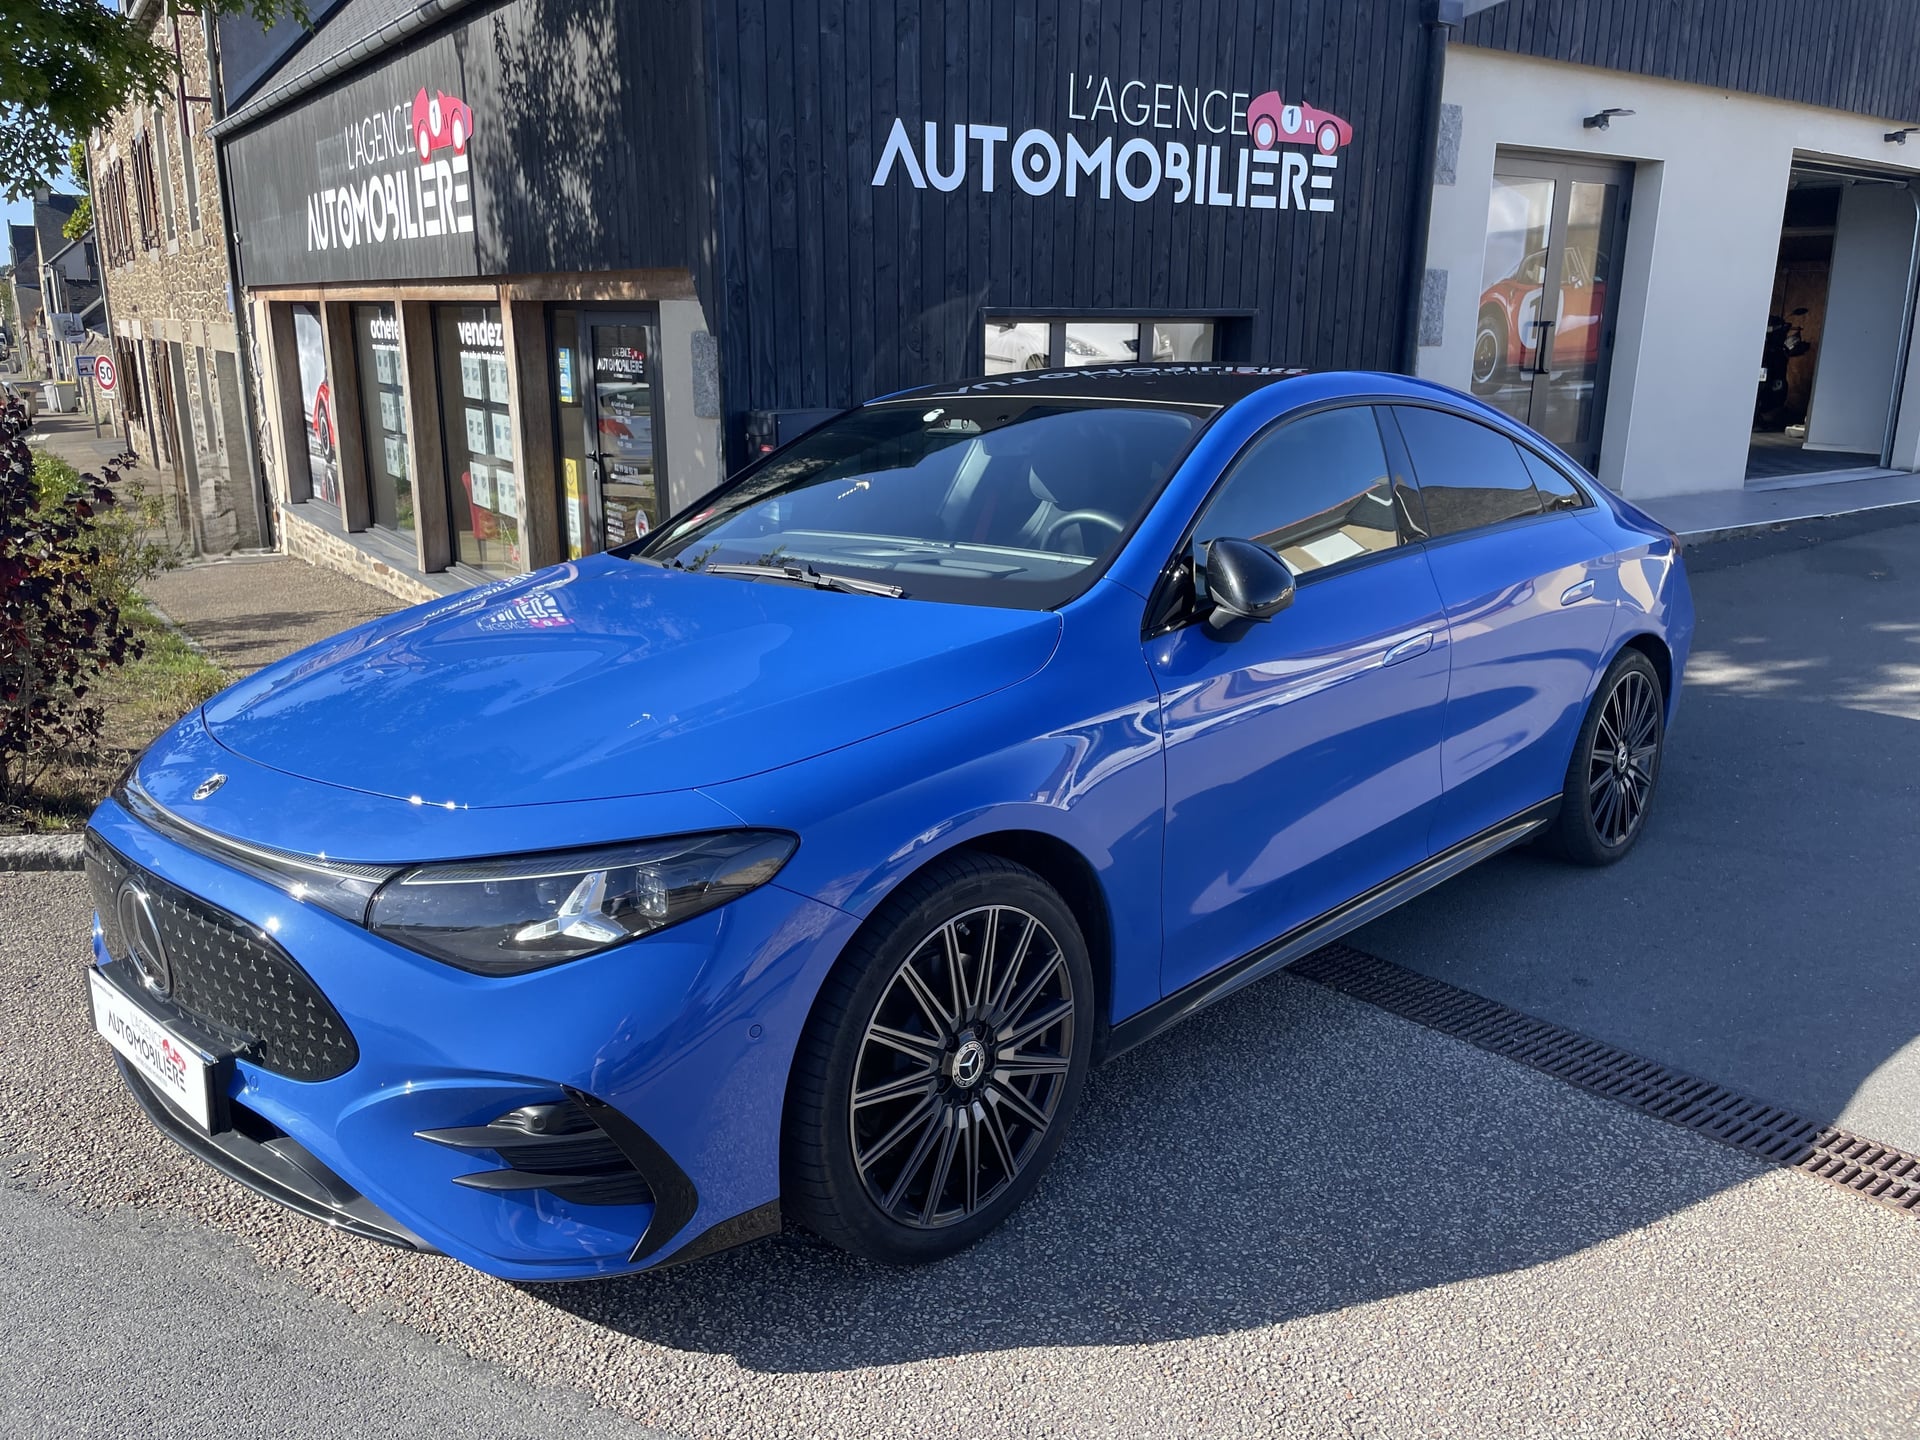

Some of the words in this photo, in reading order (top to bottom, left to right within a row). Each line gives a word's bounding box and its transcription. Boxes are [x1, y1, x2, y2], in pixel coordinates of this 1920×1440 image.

[1068, 72, 1249, 136] L'AGENCE
[1287, 107, 1296, 128] 1
[345, 102, 416, 170] L'AGENCE
[457, 307, 503, 347] vendez
[99, 366, 113, 380] 50
